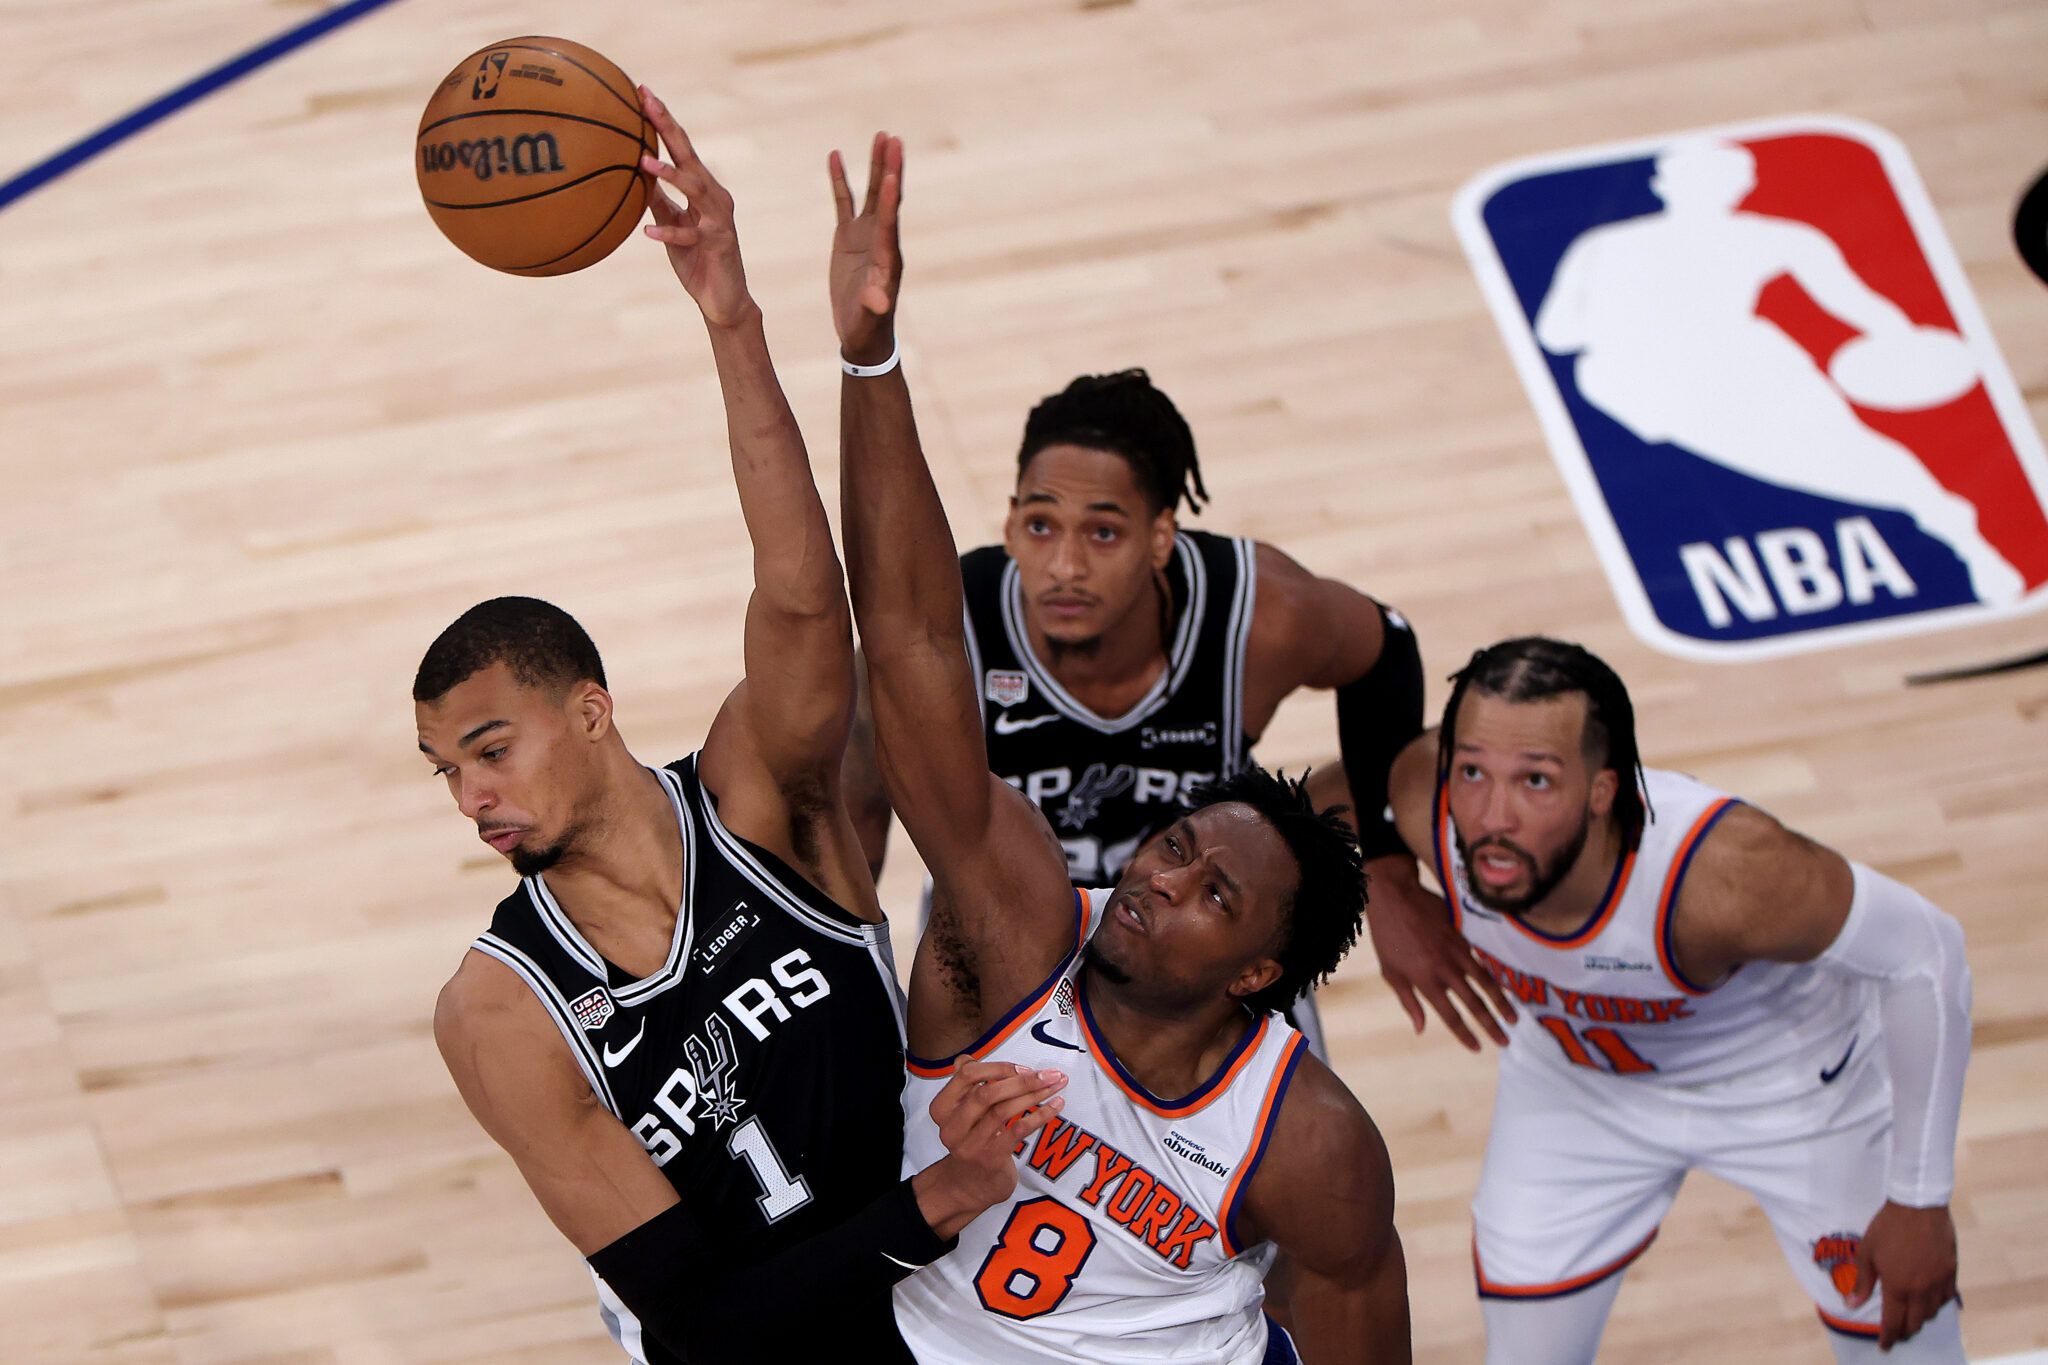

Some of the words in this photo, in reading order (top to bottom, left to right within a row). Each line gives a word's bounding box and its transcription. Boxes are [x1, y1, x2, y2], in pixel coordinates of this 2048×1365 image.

[422, 132, 564, 181] Wilson
[1678, 514, 1918, 629] NBA
[702, 914, 749, 962] LEDGER
[573, 993, 604, 1013] USA
[579, 1004, 611, 1028] 250
[1054, 992, 1074, 1017] 250
[1552, 984, 1697, 1024] YORK
[1537, 1012, 1660, 1075] 11
[1163, 1137, 1190, 1158] abu
[1189, 1152, 1230, 1177] dhabi
[1170, 1130, 1206, 1152] experience
[726, 1114, 814, 1225] 1
[1075, 1139, 1219, 1272] YORK
[972, 1194, 1098, 1321] 8
